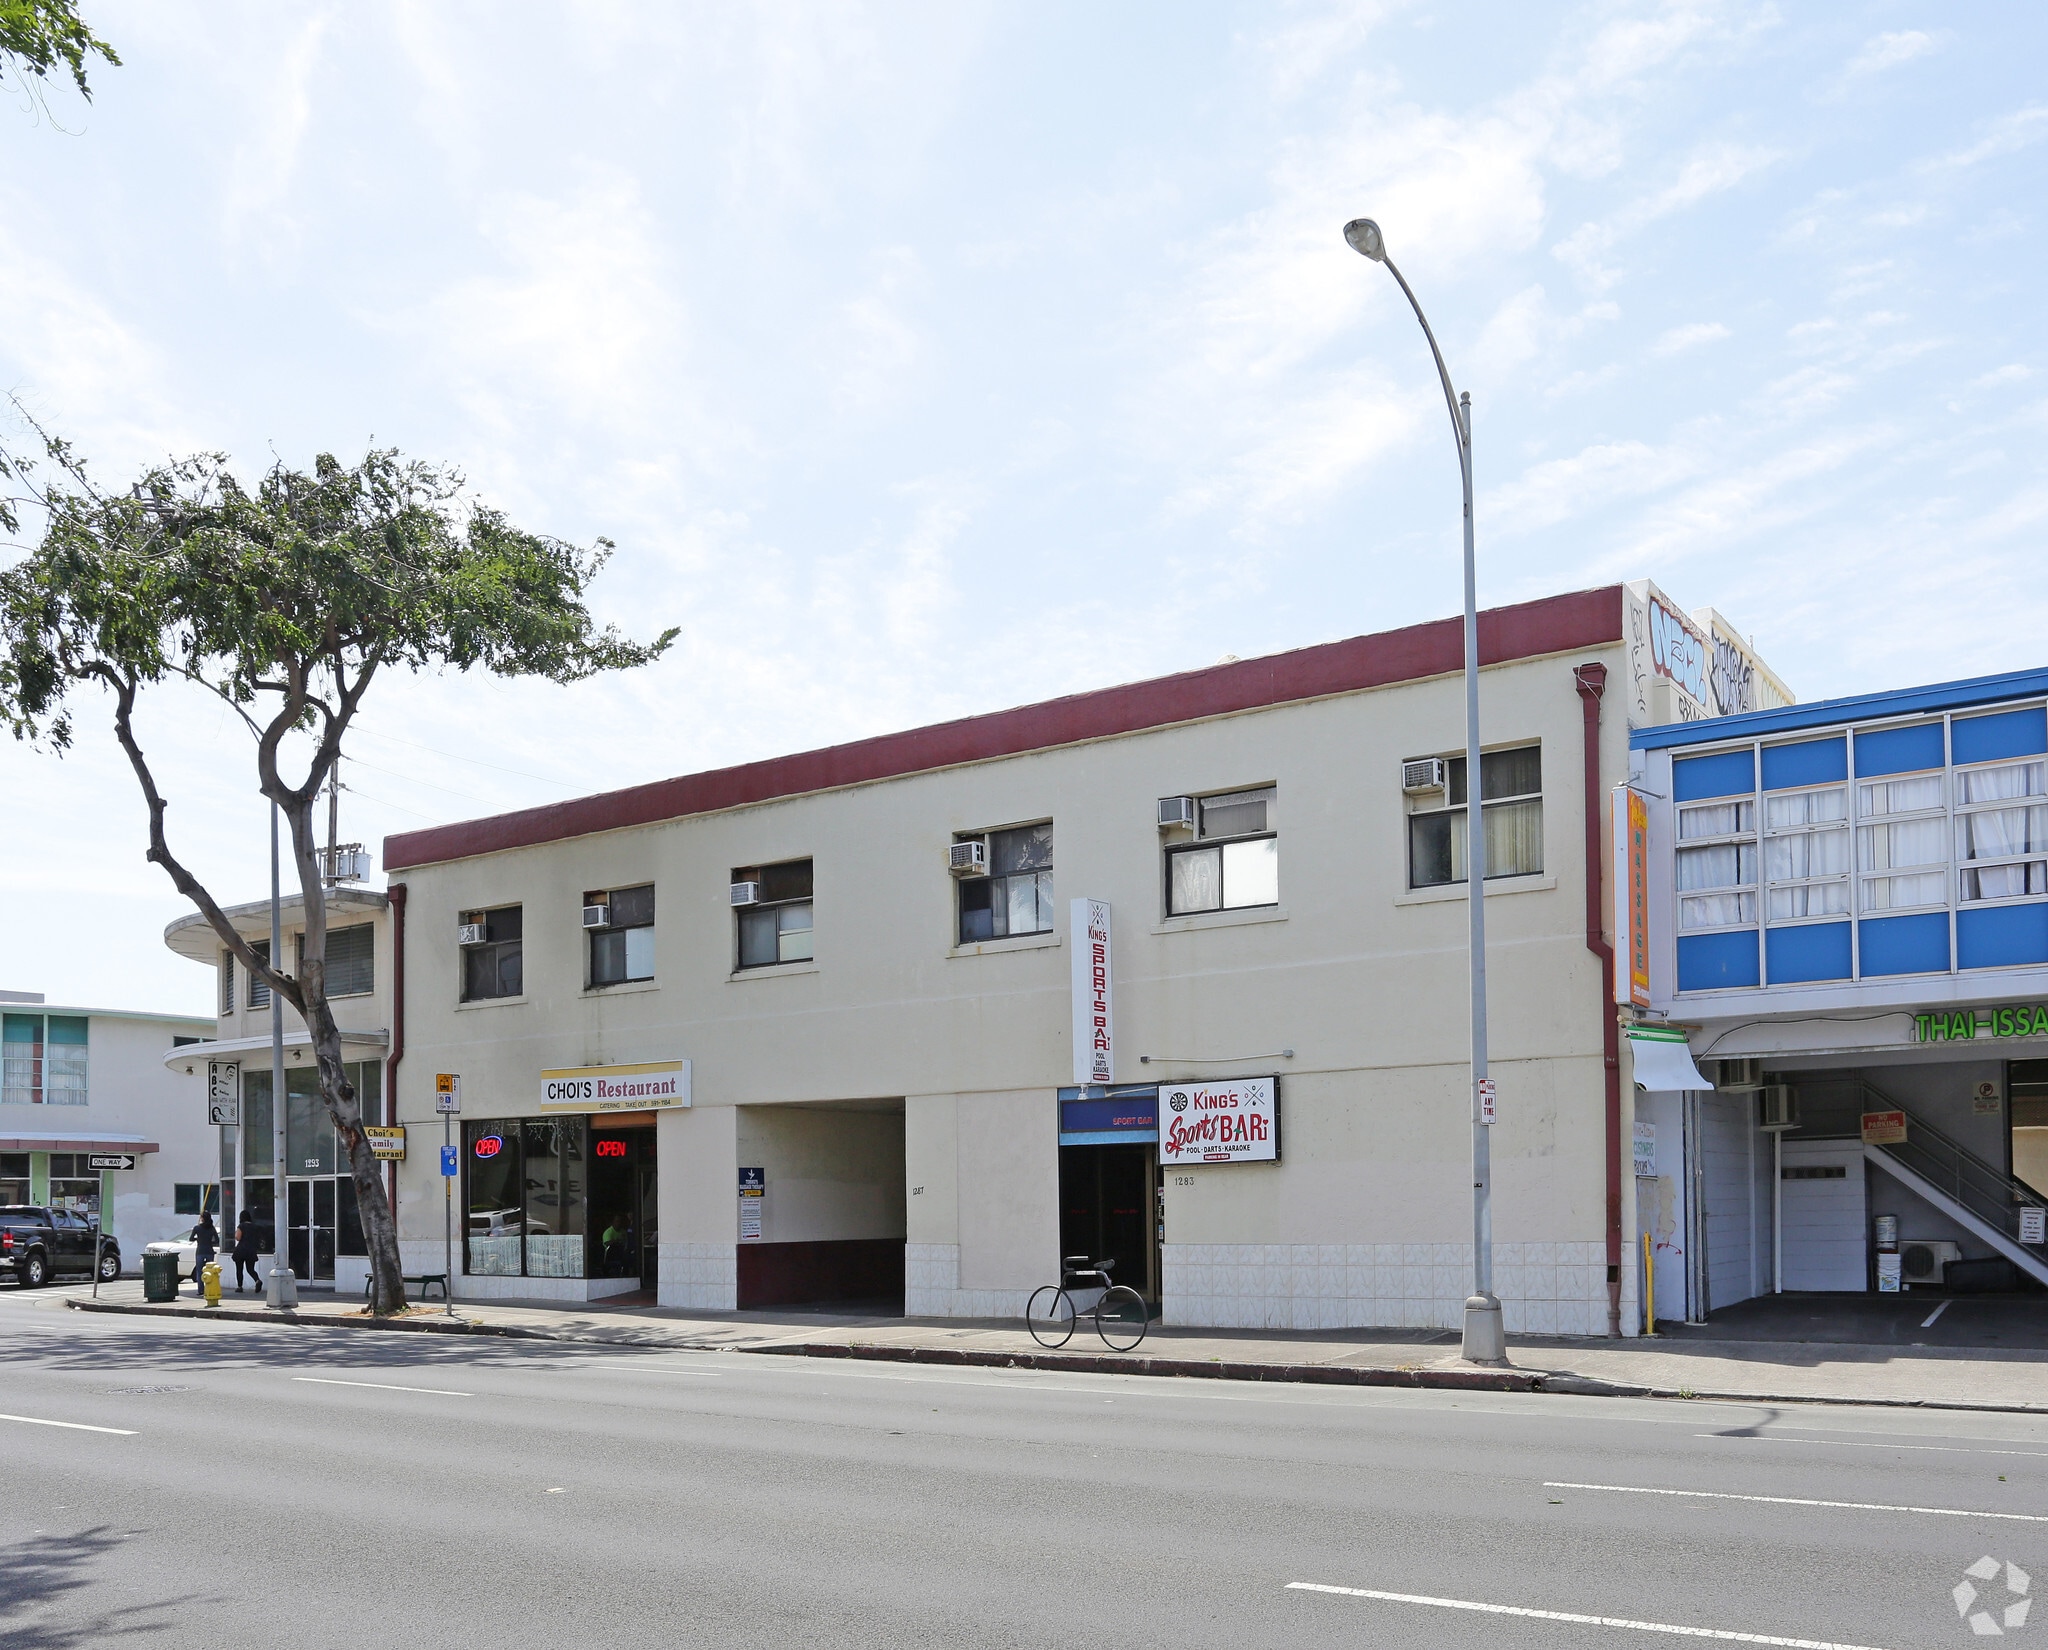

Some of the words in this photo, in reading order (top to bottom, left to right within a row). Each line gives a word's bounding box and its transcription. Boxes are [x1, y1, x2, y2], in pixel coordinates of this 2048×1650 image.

[1635, 831, 1643, 969] MASSAGE
[1092, 943, 1106, 1013] SPORTS
[547, 1081, 592, 1100] CHOI'S
[597, 1077, 676, 1098] Restaurant
[1484, 1097, 1493, 1105] ANY
[1483, 1107, 1494, 1116] TIME
[1113, 1117, 1136, 1125] SPORT
[1868, 1119, 1899, 1129] PARKING
[368, 1128, 394, 1137] Choi's
[368, 1139, 395, 1149] Family
[475, 1139, 501, 1155] OPEN
[596, 1141, 627, 1157] OPEN
[374, 1150, 403, 1158] taurant
[304, 1158, 320, 1168] 1293
[1175, 1177, 1195, 1186] 1283
